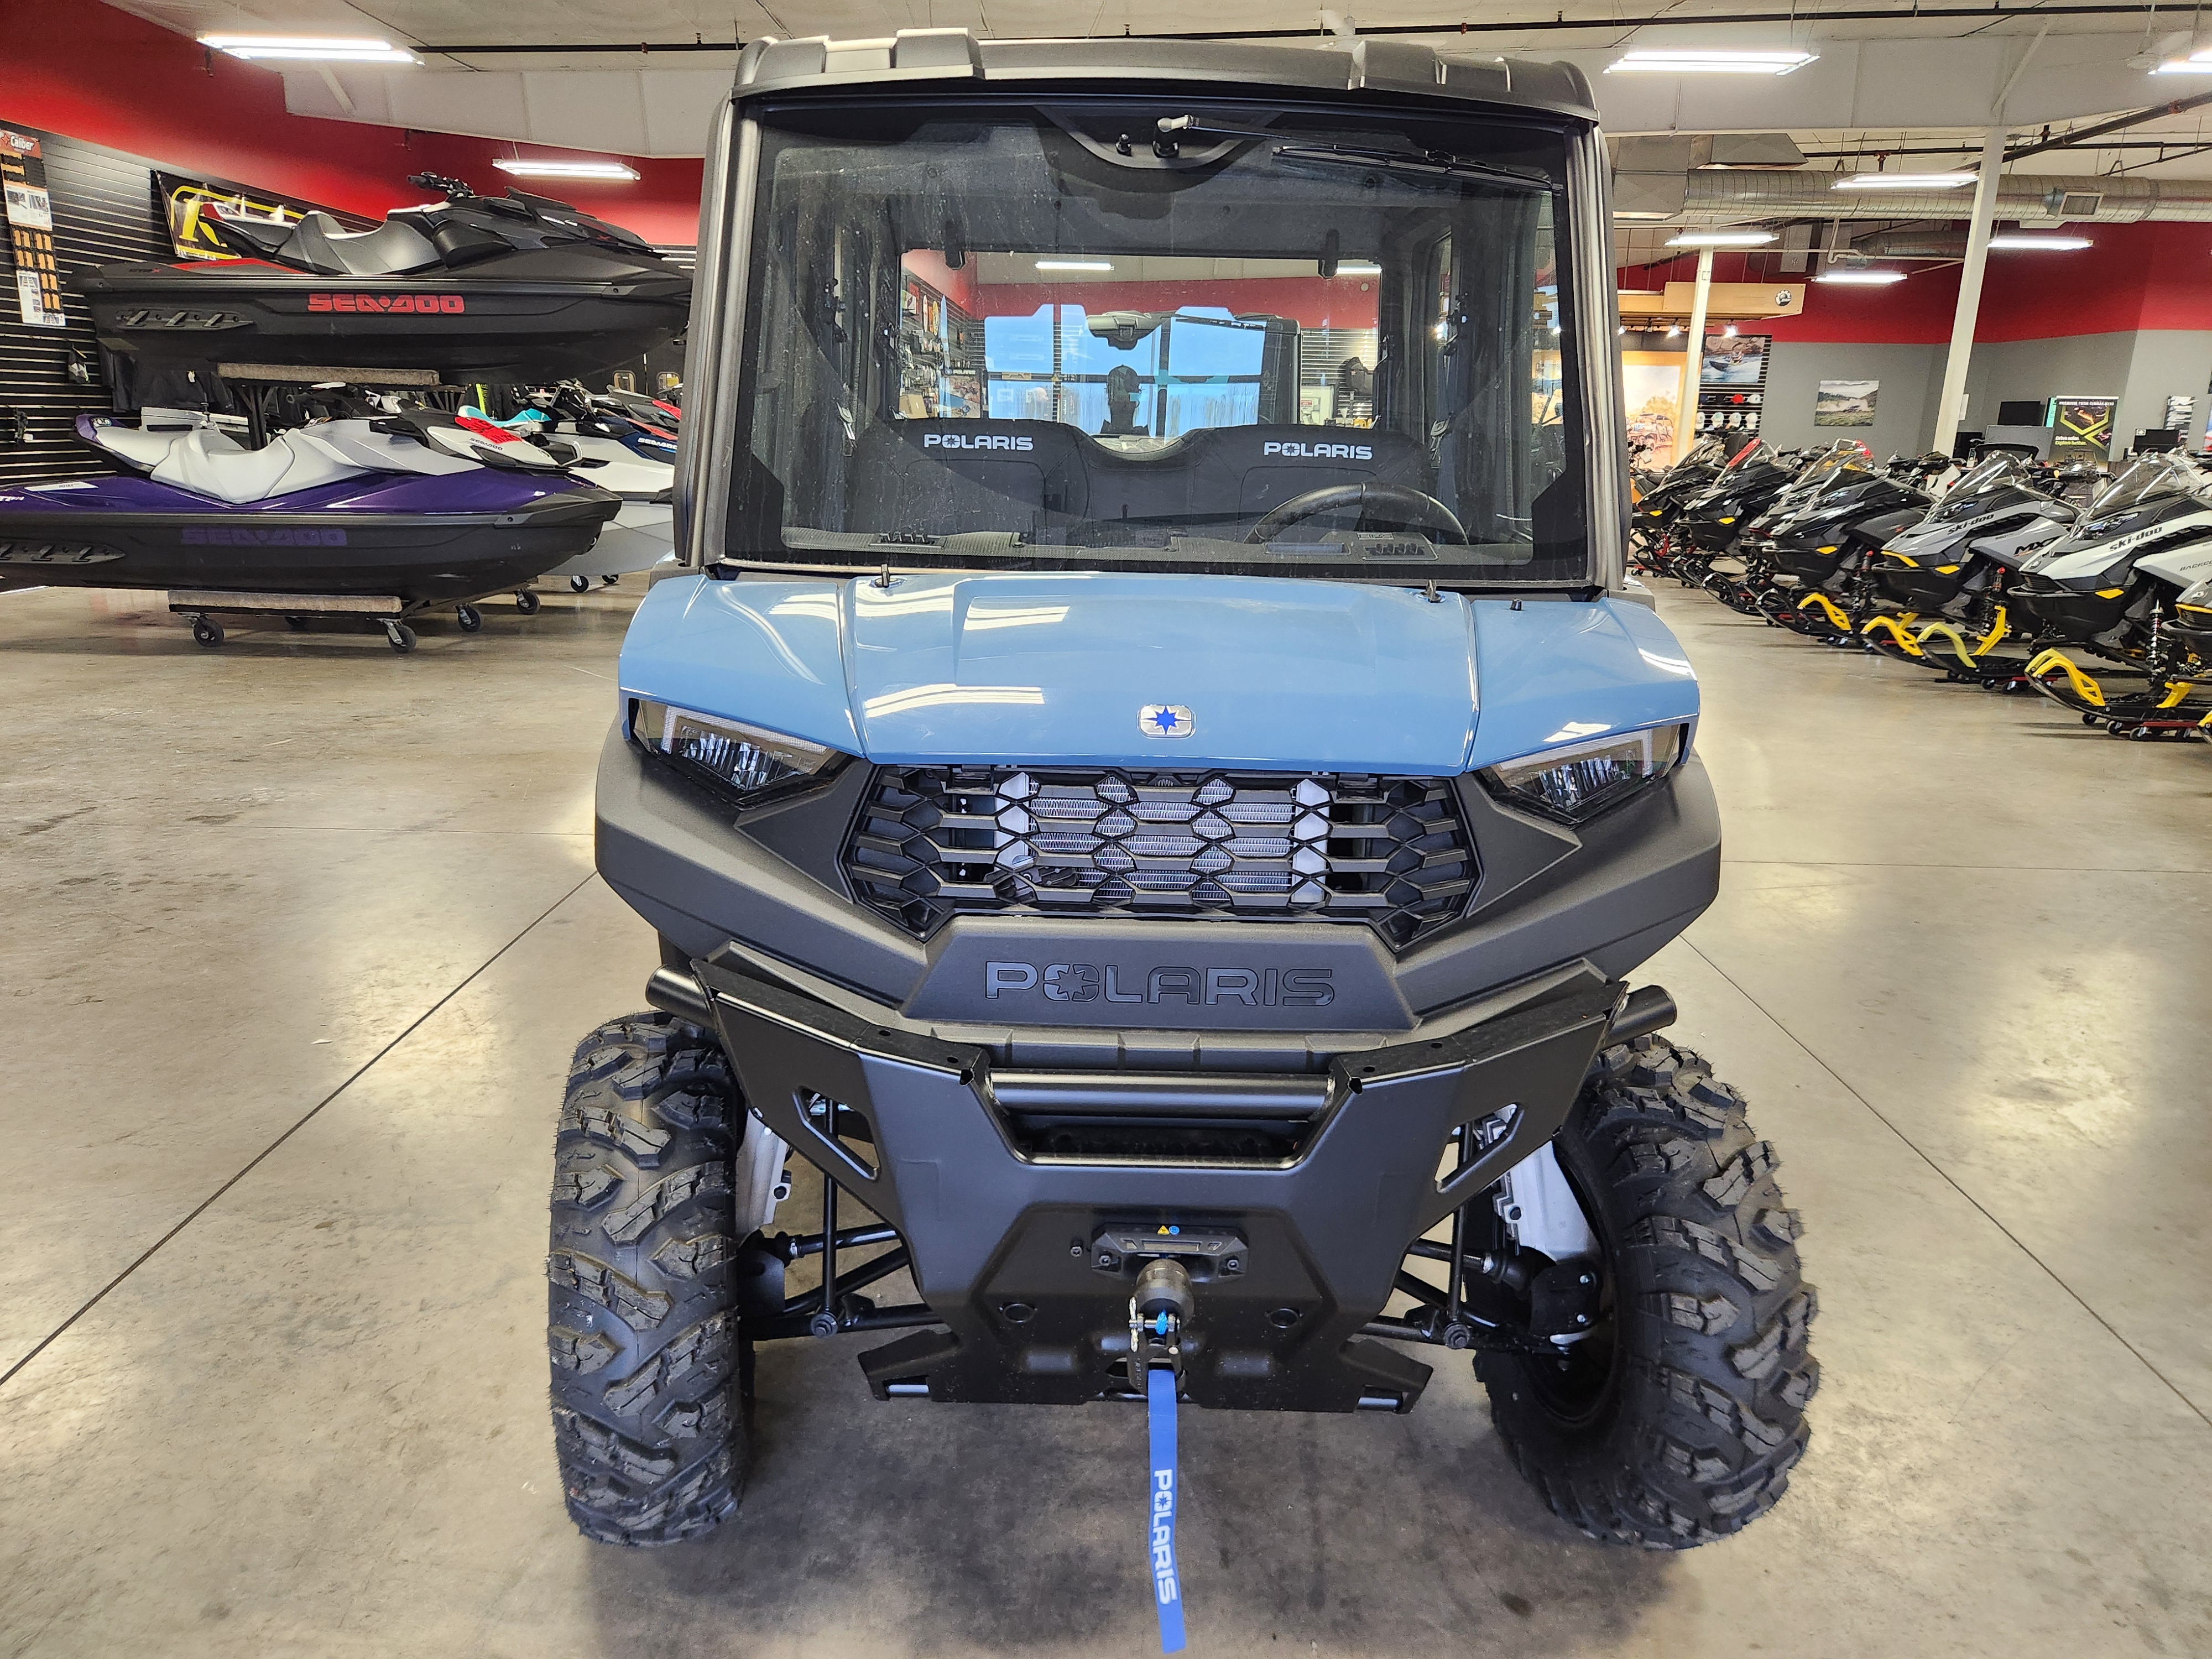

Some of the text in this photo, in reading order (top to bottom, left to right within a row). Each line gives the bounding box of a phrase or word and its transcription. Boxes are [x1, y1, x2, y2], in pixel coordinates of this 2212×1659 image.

[11, 135, 34, 151] Caliber
[924, 434, 1034, 451] POLARIS
[1264, 442, 1373, 460] POLARIS
[1947, 514, 1995, 535] ski-doo
[2109, 526, 2163, 550] ski-doo
[985, 961, 1335, 1006] POLARIS
[1152, 1469, 1178, 1605] POLARIS
